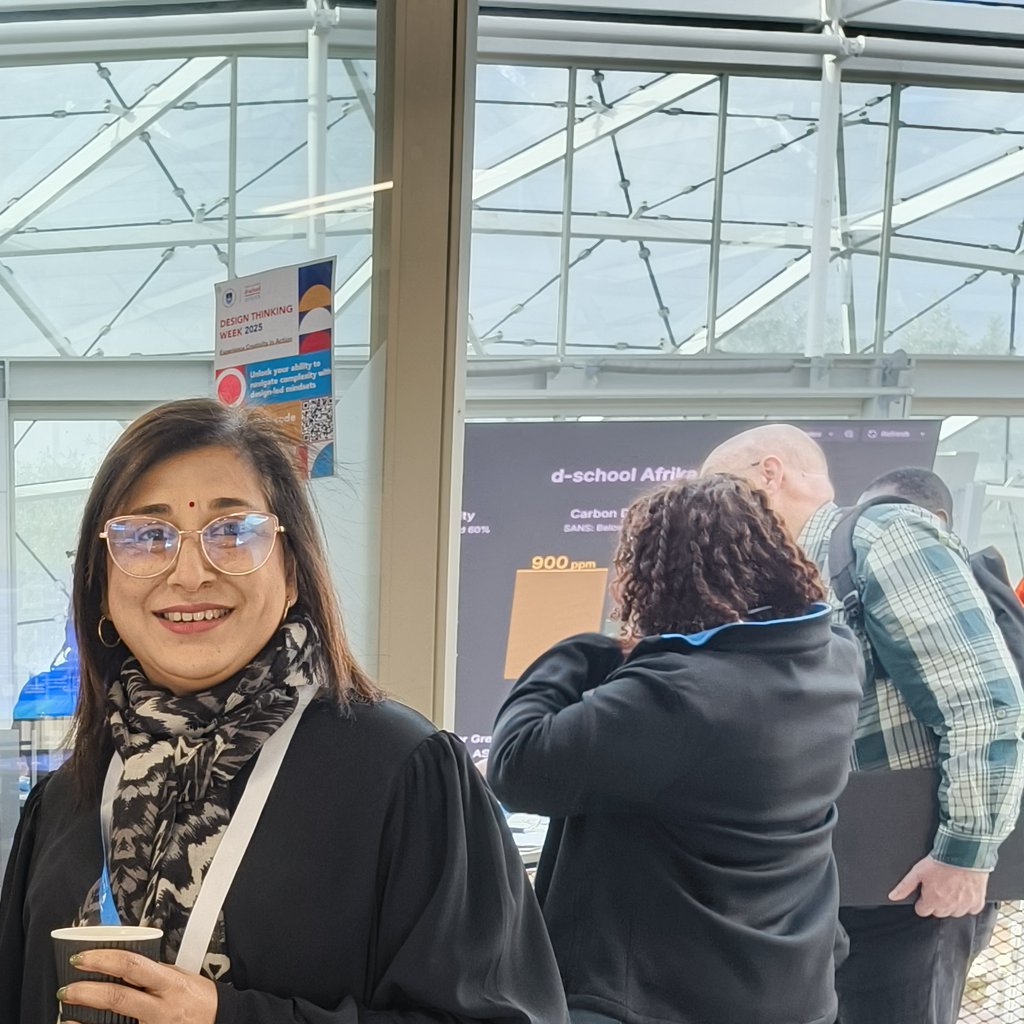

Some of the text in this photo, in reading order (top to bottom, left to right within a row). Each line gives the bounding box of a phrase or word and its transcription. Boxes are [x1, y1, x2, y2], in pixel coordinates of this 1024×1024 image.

[220, 304, 293, 328] DESIGN THINKING
[219, 322, 263, 340] WEEK 2025
[249, 360, 321, 379] Unlock your ability to
[249, 378, 279, 389] navigate
[279, 371, 318, 383] complexity
[250, 381, 317, 399] design-led mindsets
[551, 467, 637, 483] d-school
[570, 508, 617, 519] Carbon
[467, 525, 491, 534] 60%
[531, 555, 597, 571] 900 ppm
[470, 734, 493, 744] Gra
